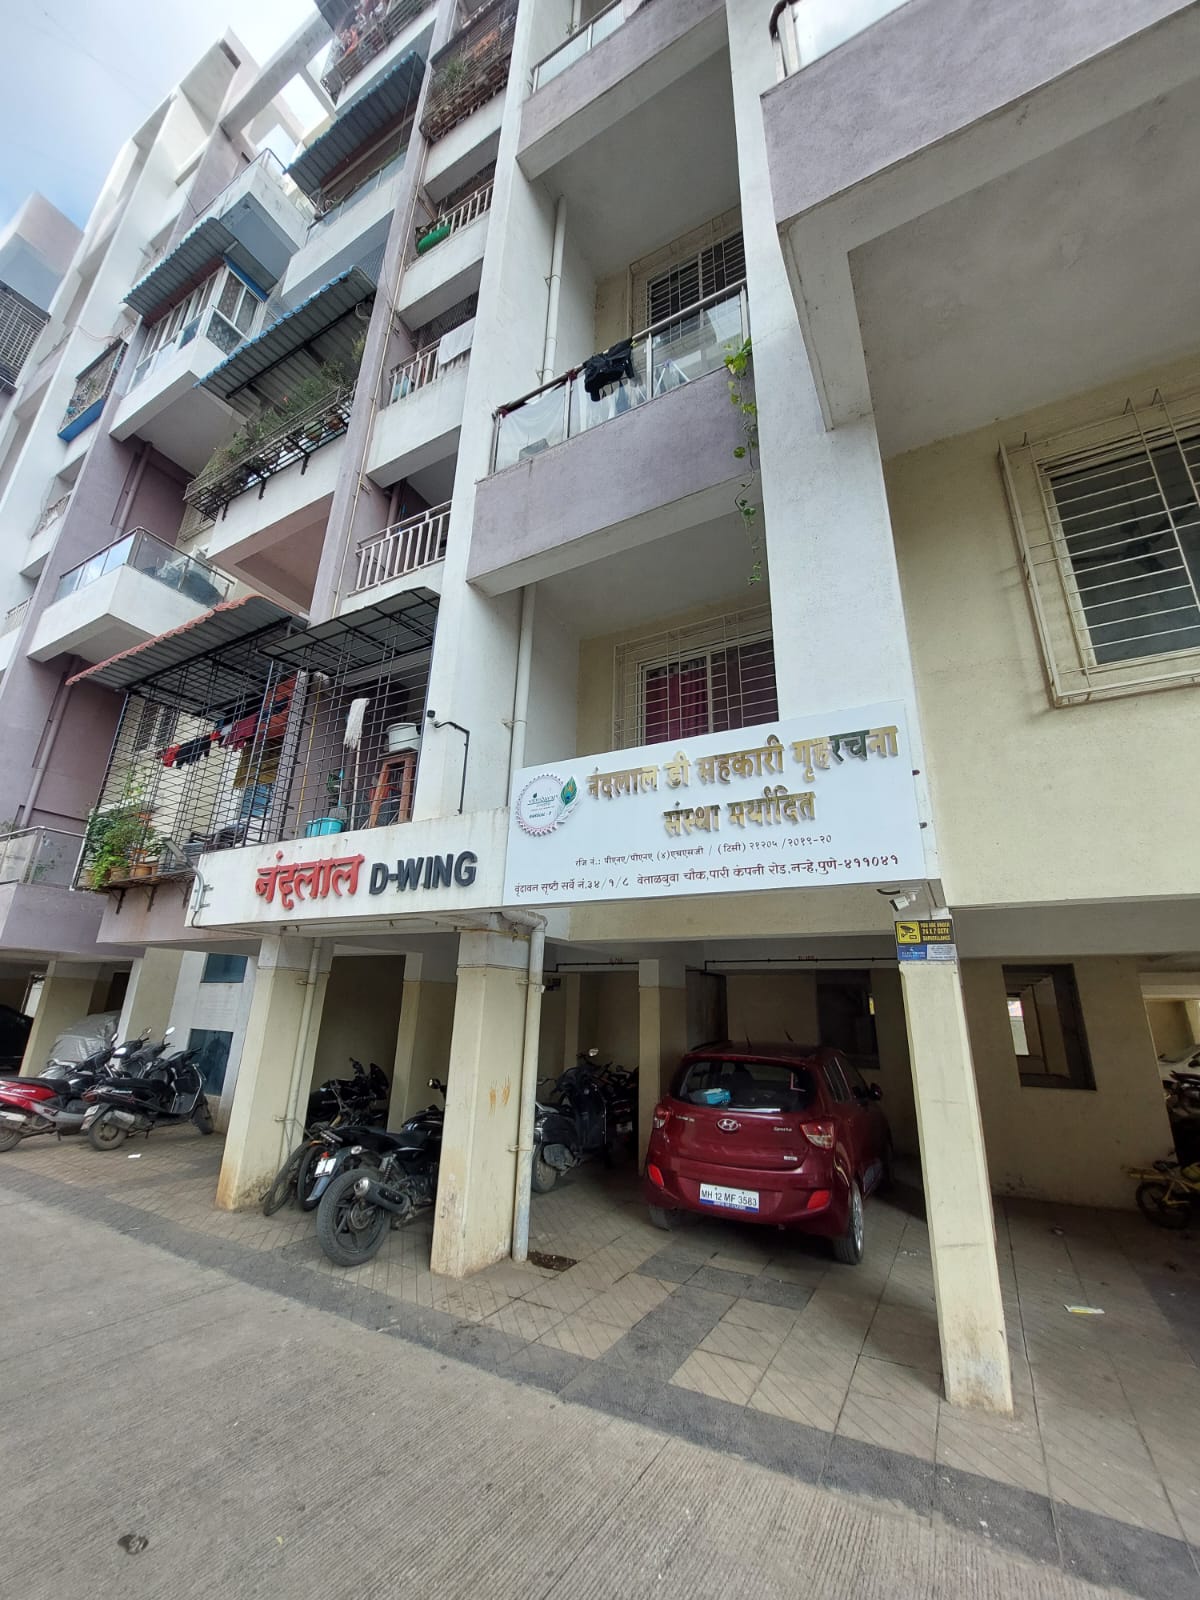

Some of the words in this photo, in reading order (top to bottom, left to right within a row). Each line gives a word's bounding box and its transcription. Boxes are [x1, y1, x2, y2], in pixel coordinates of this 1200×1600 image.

[587, 765, 658, 800] नंदलाल
[664, 751, 691, 787] डी
[696, 734, 785, 783] सहकारी
[791, 725, 899, 782] गृहरचना
[663, 801, 721, 837] संस्था
[727, 785, 817, 827] मर्यादित
[255, 850, 365, 911] नंदलाल
[369, 850, 478, 895] D-WING
[733, 864, 764, 877] कंपनी
[701, 1189, 713, 1199] MH
[715, 1192, 722, 1200] 12
[724, 1192, 736, 1202] MF
